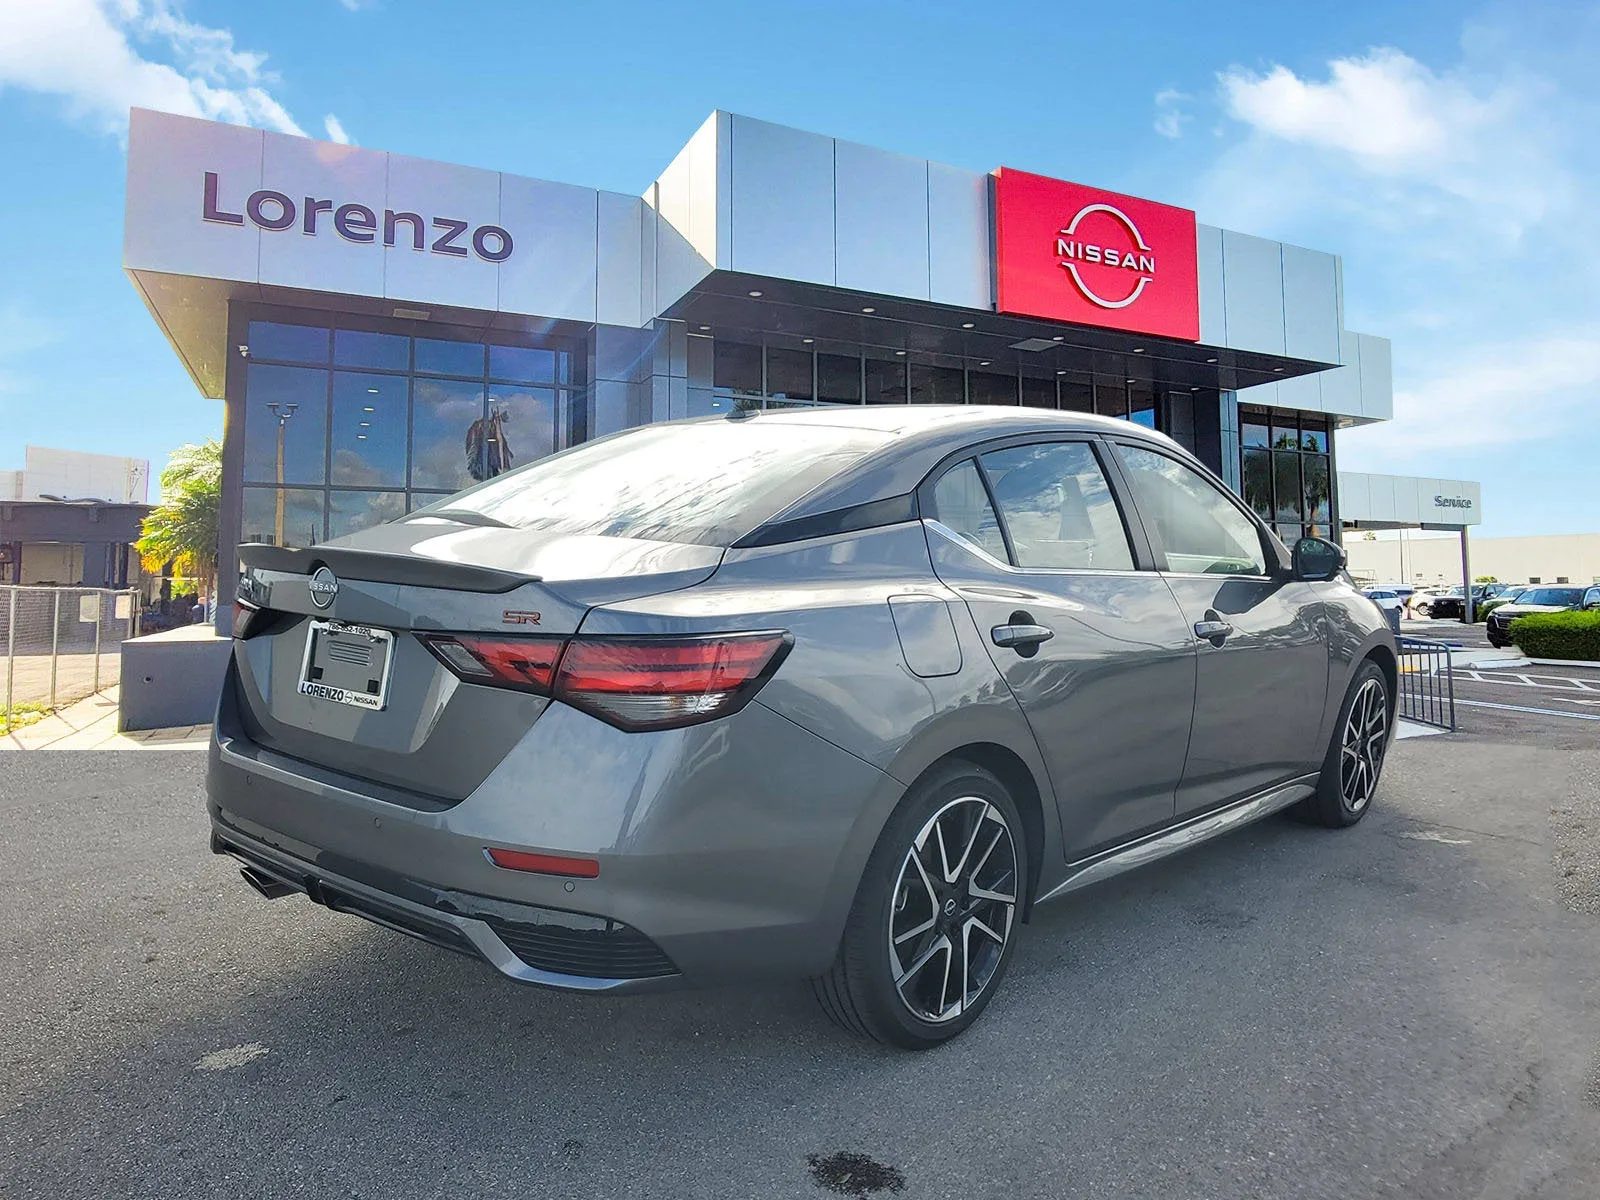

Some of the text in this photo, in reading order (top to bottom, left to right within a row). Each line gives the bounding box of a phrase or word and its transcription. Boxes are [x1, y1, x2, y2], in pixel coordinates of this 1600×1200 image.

[202, 171, 514, 262] Lorenzo
[1057, 238, 1155, 273] NISSAN
[1434, 495, 1472, 509] Service
[502, 610, 541, 625] SR
[301, 682, 378, 706] LORENZO NISSAN
